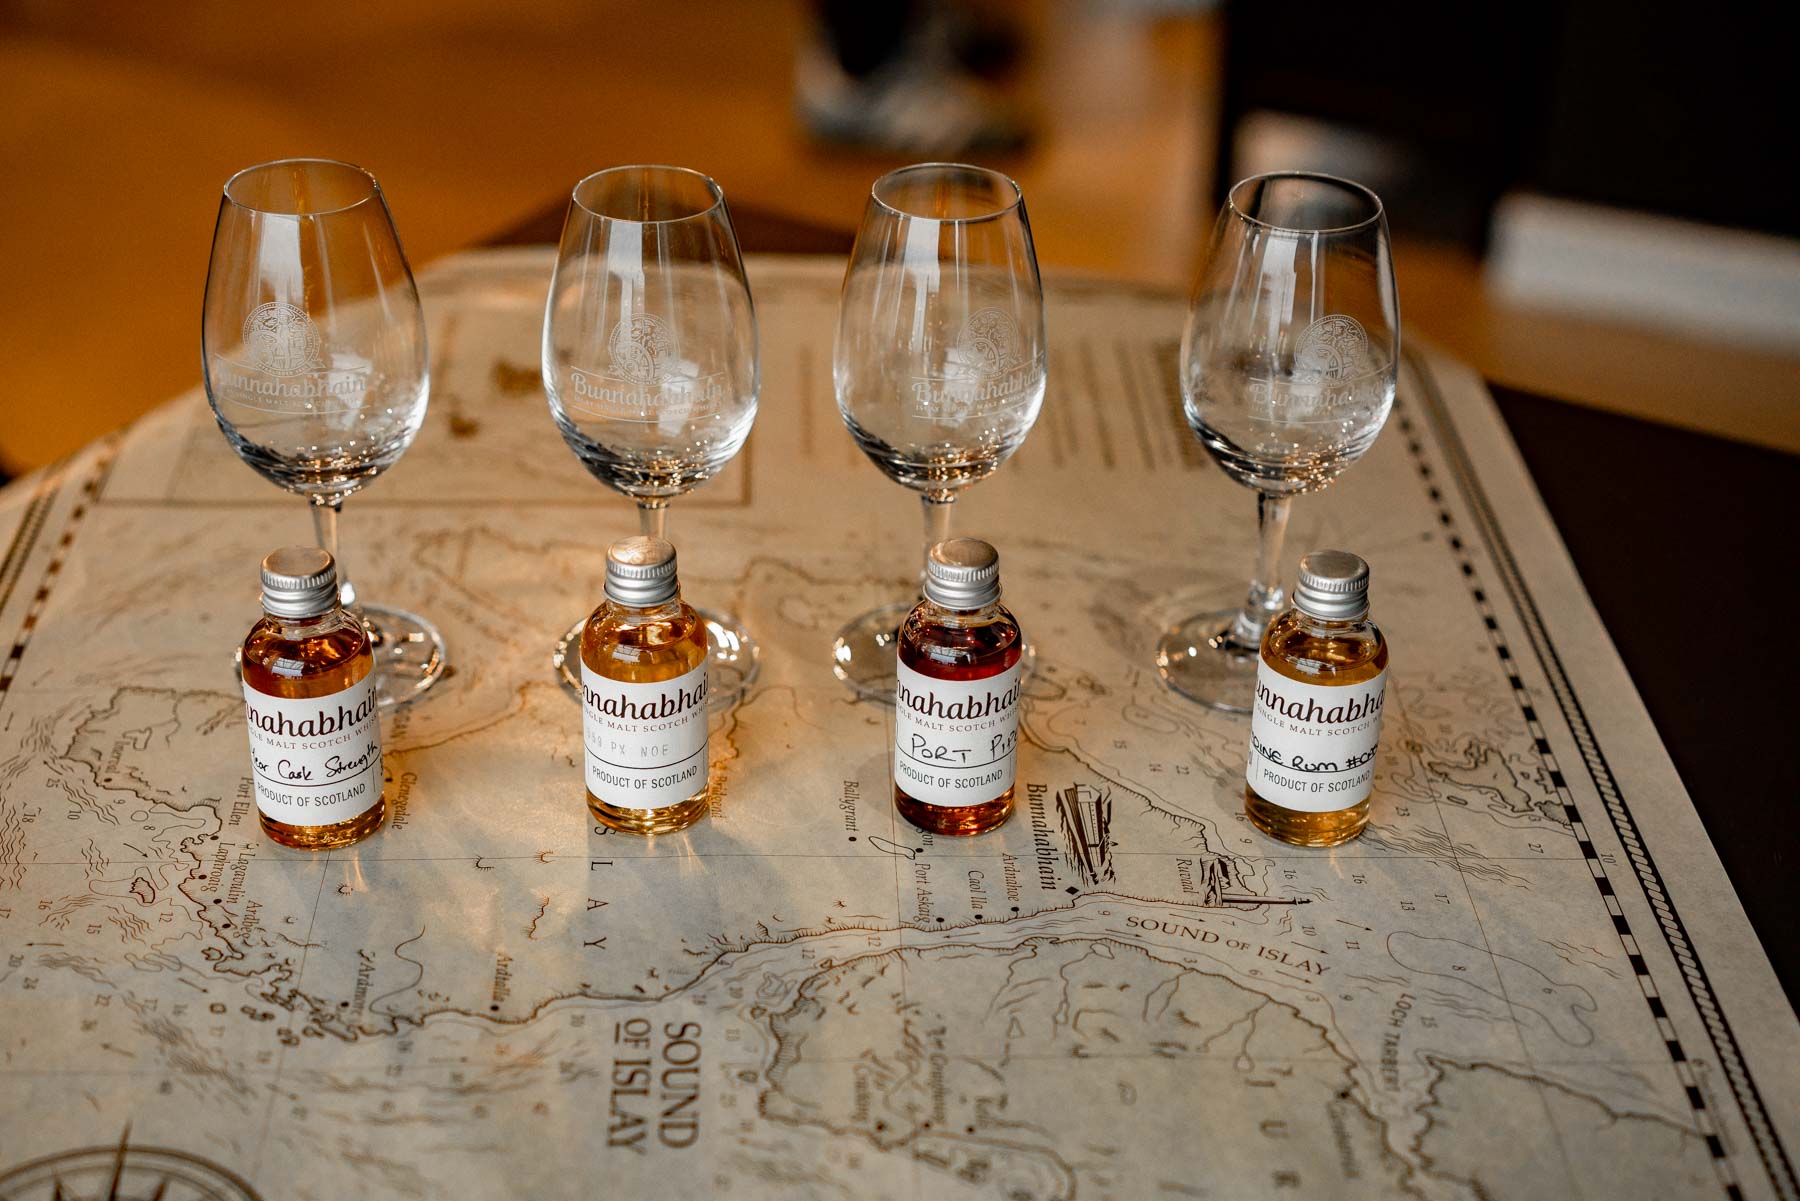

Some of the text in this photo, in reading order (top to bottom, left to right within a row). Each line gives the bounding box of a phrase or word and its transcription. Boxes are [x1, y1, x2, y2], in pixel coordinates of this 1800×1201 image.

[608, 721, 638, 732] MALT
[643, 714, 688, 732] SCOTCH
[915, 718, 944, 731] MALT
[949, 719, 995, 732] SCOTCH
[1289, 724, 1323, 737] MALT
[1328, 721, 1370, 736] SCOTCH
[266, 736, 296, 749] MALT
[302, 734, 351, 749] SCOTCH
[278, 760, 314, 781] Cask
[325, 740, 377, 777] Strength
[592, 765, 698, 789] PRODUCT OF SCOTLAND
[899, 760, 1003, 789] PRODUCT OF SCOTLAND
[1263, 768, 1371, 793] PRODUCT OF SCOTLAND
[228, 776, 254, 827] Port Ellen
[257, 781, 366, 806] PRODUCT OF SCOTLAND
[392, 771, 417, 831] Glenegedale
[22, 812, 37, 824] 18
[67, 809, 82, 820] 10
[839, 780, 860, 832] Ballygrant
[1394, 806, 1410, 818] 23
[1026, 782, 1062, 891] Bunnahabhain
[1528, 843, 1545, 854] 27
[201, 842, 236, 894] Laphroaig
[226, 852, 256, 904] Lagavulin
[913, 861, 931, 883] Port
[1002, 853, 1020, 902] Ardnahoe
[1175, 857, 1200, 894] Ruvaal
[1283, 868, 1298, 880] 16
[1352, 873, 1368, 885] 16
[968, 870, 985, 894] Caol
[38, 900, 53, 911] 16
[912, 884, 931, 924] Askaig
[1400, 900, 1416, 912] 13
[1434, 893, 1450, 904] 17
[86, 922, 102, 935] 15
[159, 911, 174, 924] 12
[232, 900, 263, 942] Ardbeg
[1302, 925, 1317, 937] 10
[1126, 916, 1331, 977] SOUND OF ISLAY
[1344, 939, 1361, 951] 11
[1452, 964, 1466, 972] 8
[1385, 992, 1416, 1029] LOCH
[606, 1018, 651, 1155] OF ISLAY
[657, 1021, 702, 1149] SOUND
